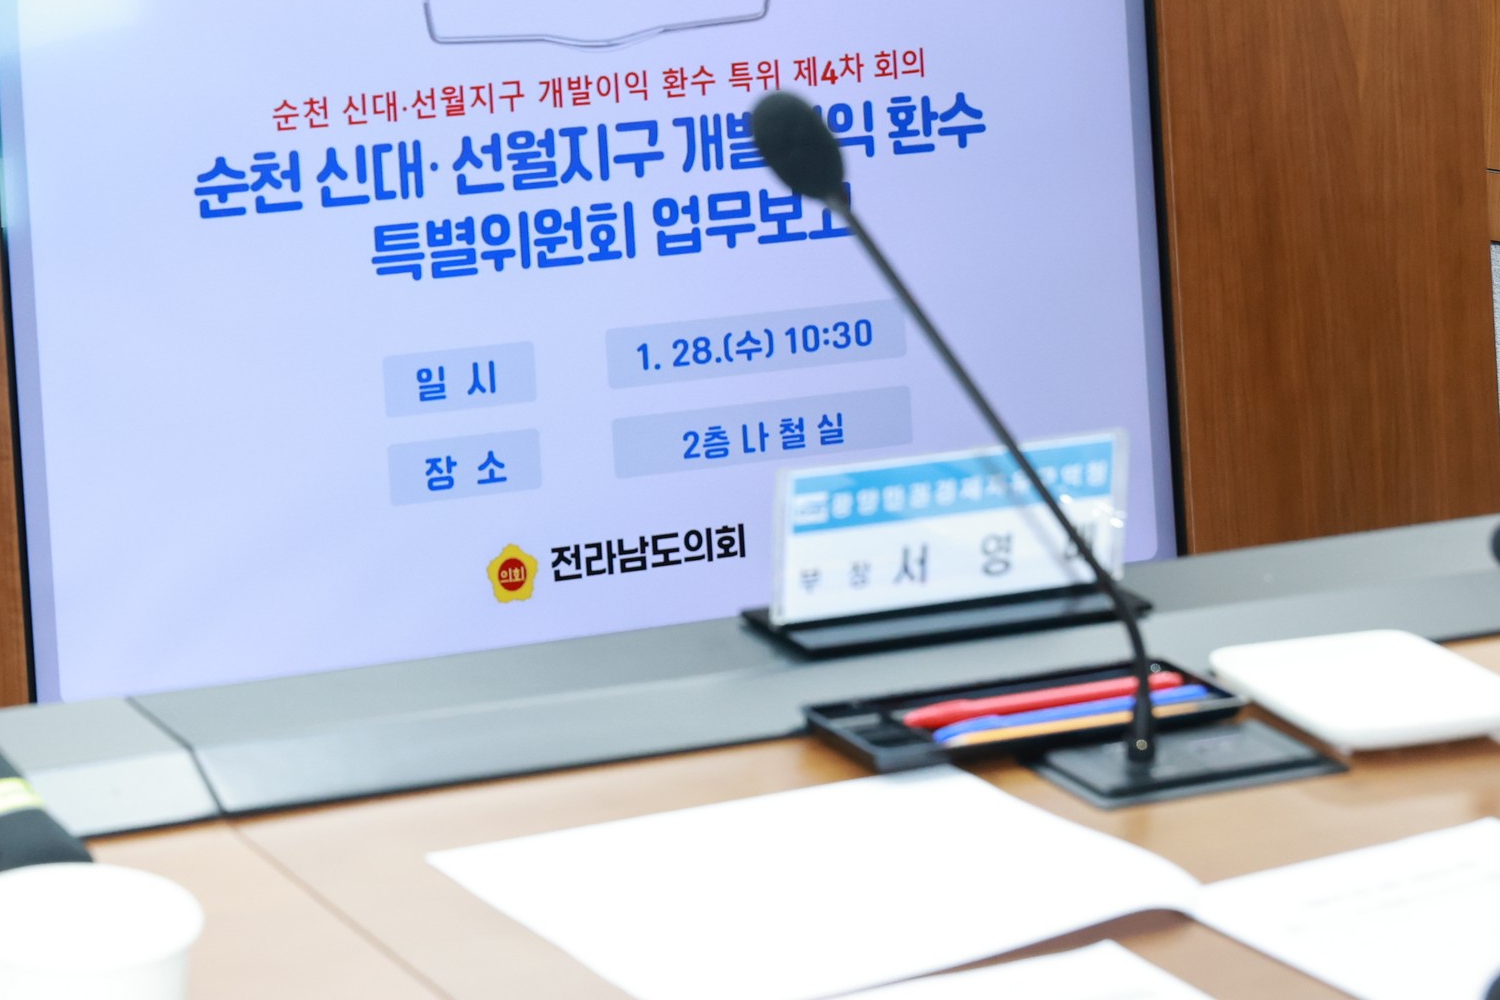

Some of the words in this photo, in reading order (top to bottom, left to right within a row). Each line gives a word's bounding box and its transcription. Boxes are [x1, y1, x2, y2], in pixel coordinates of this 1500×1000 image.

[273, 96, 329, 131] 순천
[343, 81, 526, 125] 신대·선월지구
[539, 70, 649, 108] 개발이익
[661, 65, 716, 98] 환수
[728, 59, 781, 92] 특위
[793, 51, 865, 87] 제4차
[874, 47, 926, 79] 회의
[194, 150, 303, 219] 순천
[886, 92, 986, 155] 환수
[371, 201, 636, 280] 특별위원회
[784, 319, 873, 354] 10:30
[500, 566, 526, 584] 의회
[550, 523, 747, 582] 전라남도의회
